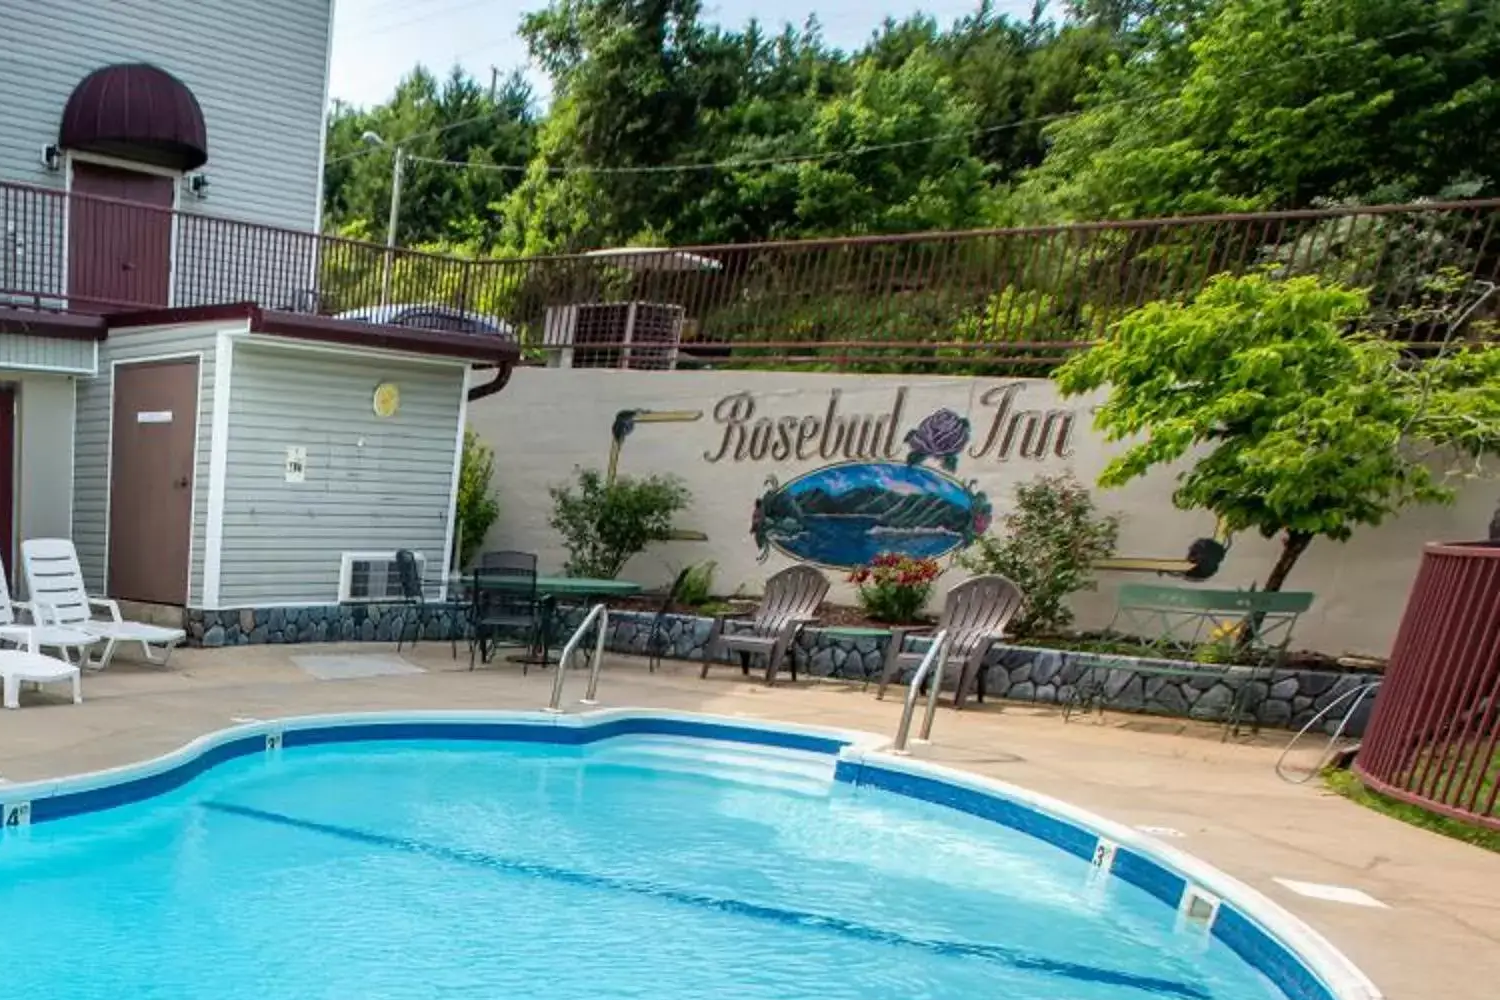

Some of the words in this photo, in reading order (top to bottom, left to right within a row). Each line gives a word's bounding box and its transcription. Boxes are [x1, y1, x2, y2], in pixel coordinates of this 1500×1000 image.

[704, 386, 909, 463] Rosebud
[968, 381, 1076, 463] Inn
[6, 807, 19, 825] 4
